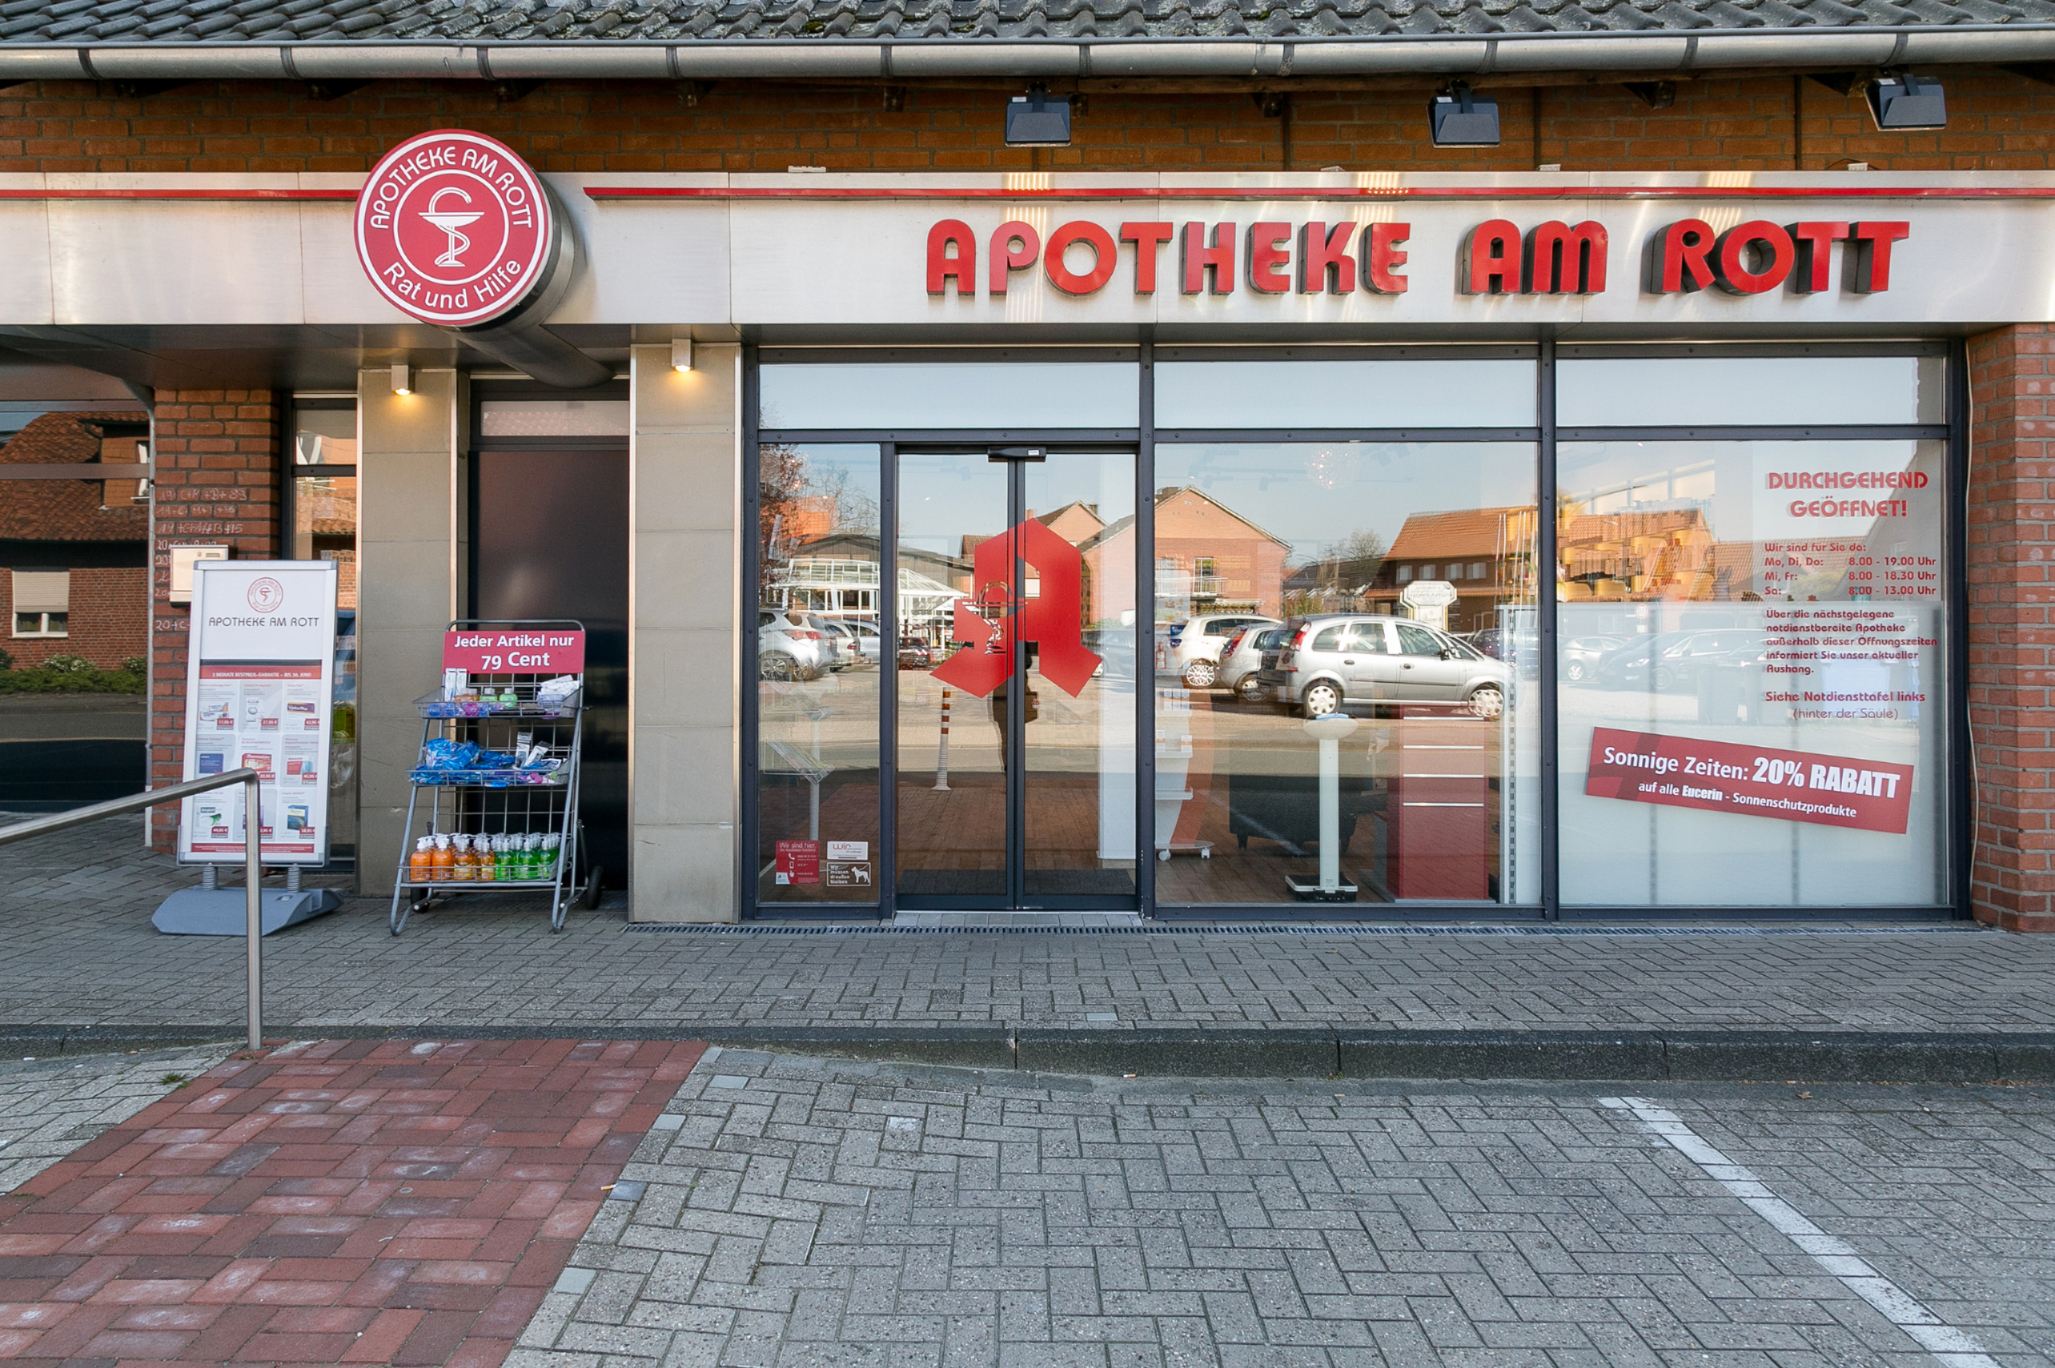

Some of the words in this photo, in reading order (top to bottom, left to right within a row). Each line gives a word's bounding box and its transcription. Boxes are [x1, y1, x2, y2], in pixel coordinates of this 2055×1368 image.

[370, 146, 456, 229] APOTHEKE
[461, 148, 498, 178] AM
[495, 172, 533, 228] ROTT
[926, 219, 1411, 296] APOTHEKE
[1462, 219, 1608, 296] AM
[1650, 218, 1910, 296] ROTT
[383, 262, 422, 300] Rat
[424, 288, 469, 308] und
[473, 260, 521, 303] Hilfe
[1766, 471, 1929, 490] DURCHGEHEND
[1788, 496, 1908, 517] GEÖFFNET!
[1764, 543, 1783, 552] Wir
[1786, 543, 1809, 552] sind
[1811, 543, 1828, 552] für
[1830, 543, 1846, 552] Sie
[1849, 543, 1867, 552] da:
[1764, 557, 1785, 568] Mo,
[1788, 557, 1803, 568] Di,
[1806, 557, 1824, 566] Do:
[1848, 557, 1873, 566] 8.00
[1884, 557, 1914, 566] 19.00
[1917, 557, 1936, 566] Uhr
[1764, 572, 1782, 582] Mi,
[1784, 572, 1798, 580] Fr:
[1848, 572, 1873, 580] 8.00
[1884, 572, 1914, 580] 18.30
[1917, 572, 1936, 580] Uhr
[1764, 586, 1782, 595] Sa:
[1848, 586, 1873, 595] 8.00
[1884, 586, 1914, 595] 13.00
[1917, 586, 1936, 595] Uhr
[1766, 608, 1792, 619] Über
[1793, 609, 1810, 619] die
[1813, 609, 1895, 620] nächstgelegene
[208, 617, 266, 626] APOTHEKE
[269, 617, 287, 626] AM
[290, 617, 320, 626] ROTT
[1766, 623, 1853, 633] notdienstbereite
[1855, 623, 1906, 634] Apotheke
[454, 634, 494, 648] Jeder
[496, 634, 545, 647] Artikel
[549, 636, 574, 646] nur
[1766, 636, 1820, 646] außerhalb
[1822, 636, 1856, 646] dieser
[1858, 635, 1938, 648] Öffnungszeiten
[1766, 650, 1818, 660] informiert
[1820, 650, 1837, 660] Sie
[1839, 652, 1869, 660] unser
[1872, 650, 1919, 660] aktueller
[481, 655, 502, 671] 79
[508, 652, 550, 667] Cent
[1766, 664, 1814, 675] Aushang.
[1766, 692, 1800, 702] Siehe
[1804, 692, 1893, 702] Notdiensttafel
[1897, 692, 1926, 702] links
[1793, 708, 1836, 720] (hinter
[1838, 708, 1858, 718] der
[1860, 708, 1899, 720] Säule)
[1603, 746, 1679, 773] Sonnige
[1684, 756, 1749, 781] Zeiten:
[1752, 756, 1804, 788] 20%
[1809, 764, 1900, 798] RABATT
[1638, 781, 1658, 794] auf
[1659, 783, 1680, 796] alle
[1682, 785, 1723, 801] Eucerin
[1732, 791, 1858, 818] Sonnenschutzprodukte
